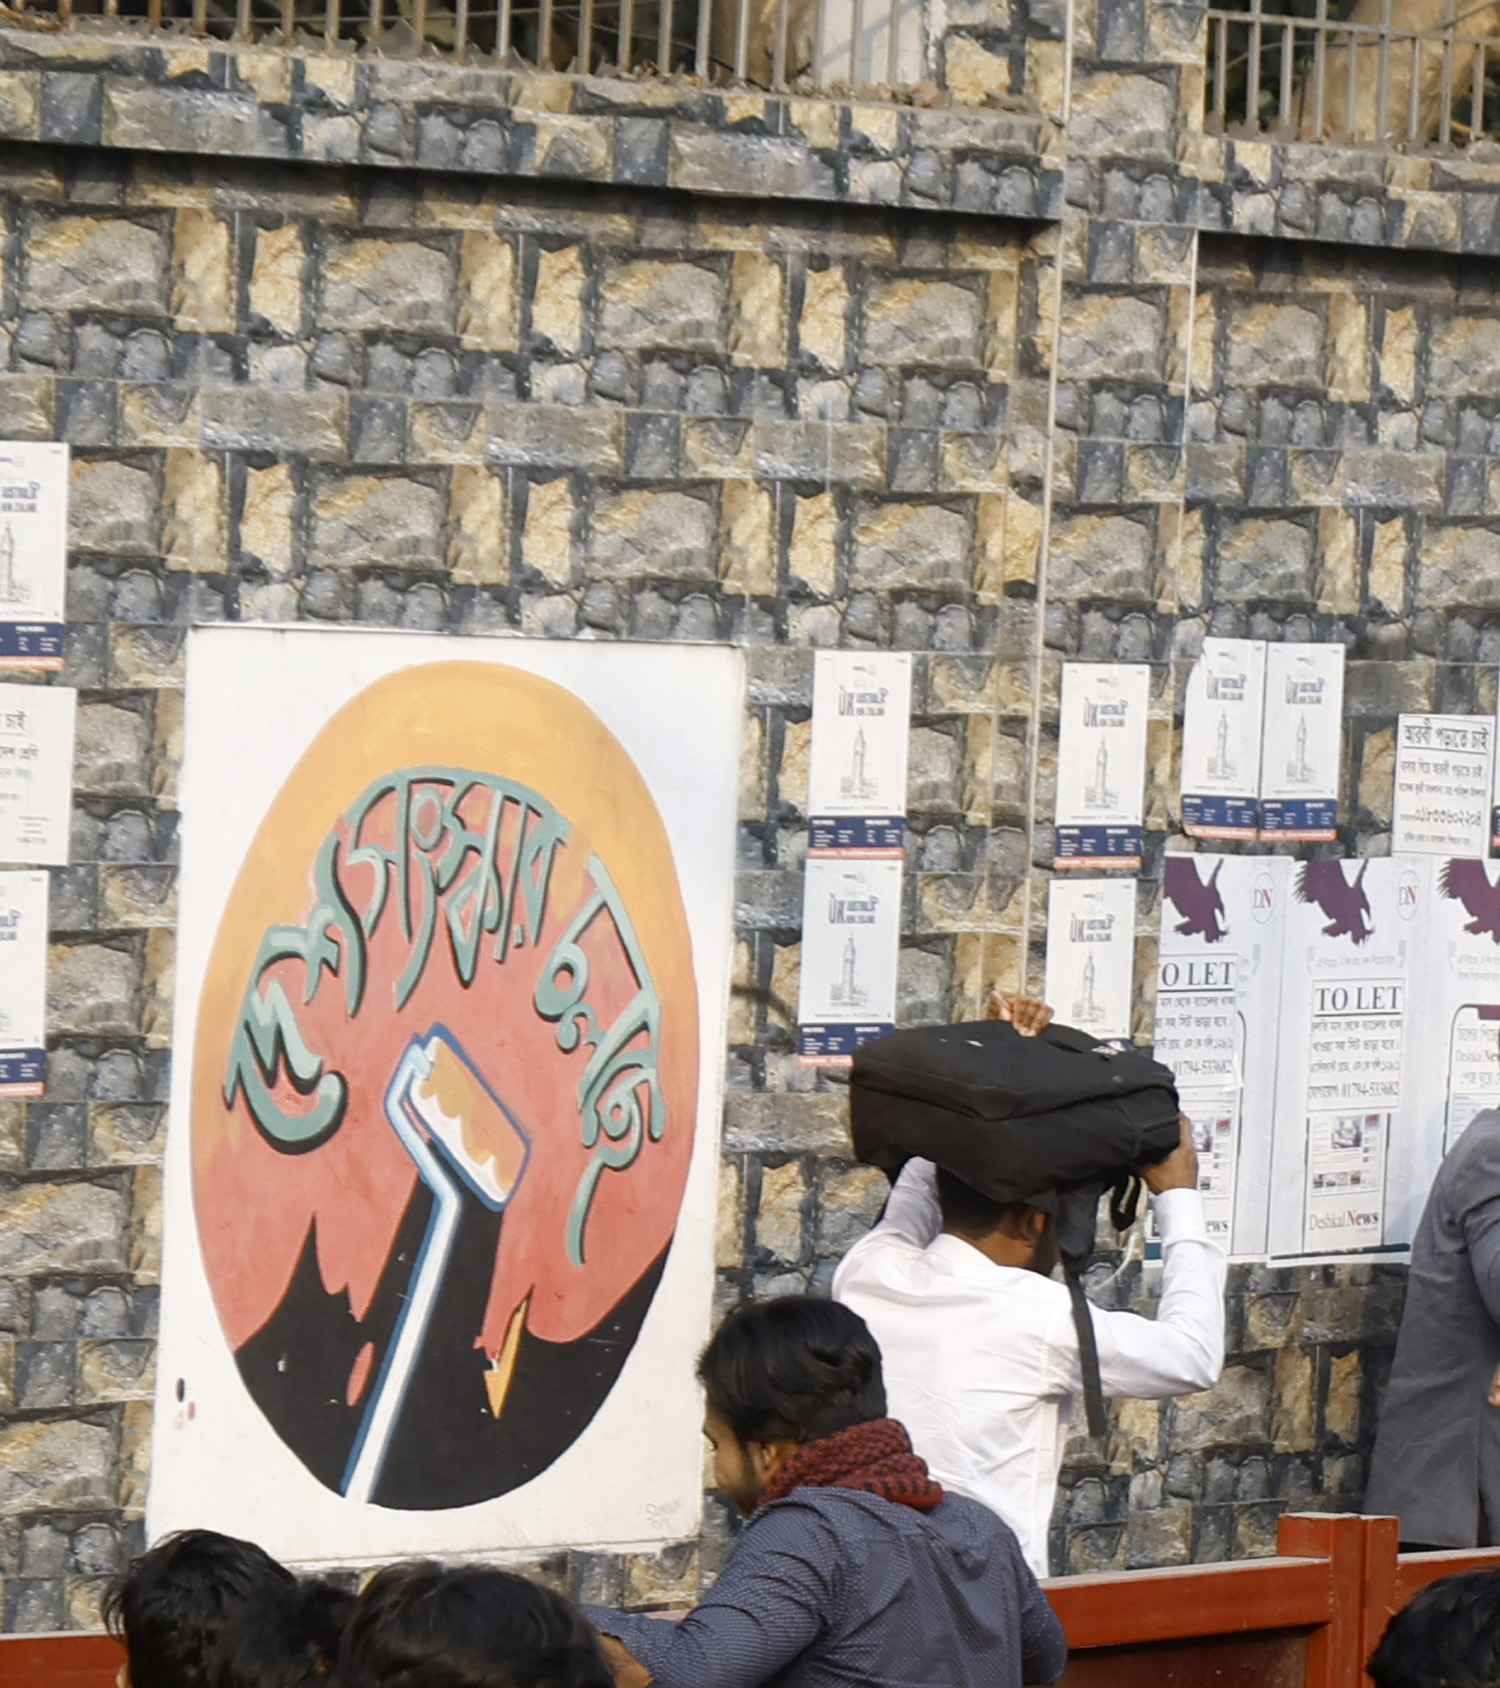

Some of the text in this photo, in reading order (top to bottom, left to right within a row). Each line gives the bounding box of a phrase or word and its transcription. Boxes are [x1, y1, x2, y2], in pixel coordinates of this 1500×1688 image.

[1188, 961, 1236, 986] LET
[1315, 986, 1402, 1012] TO LET
